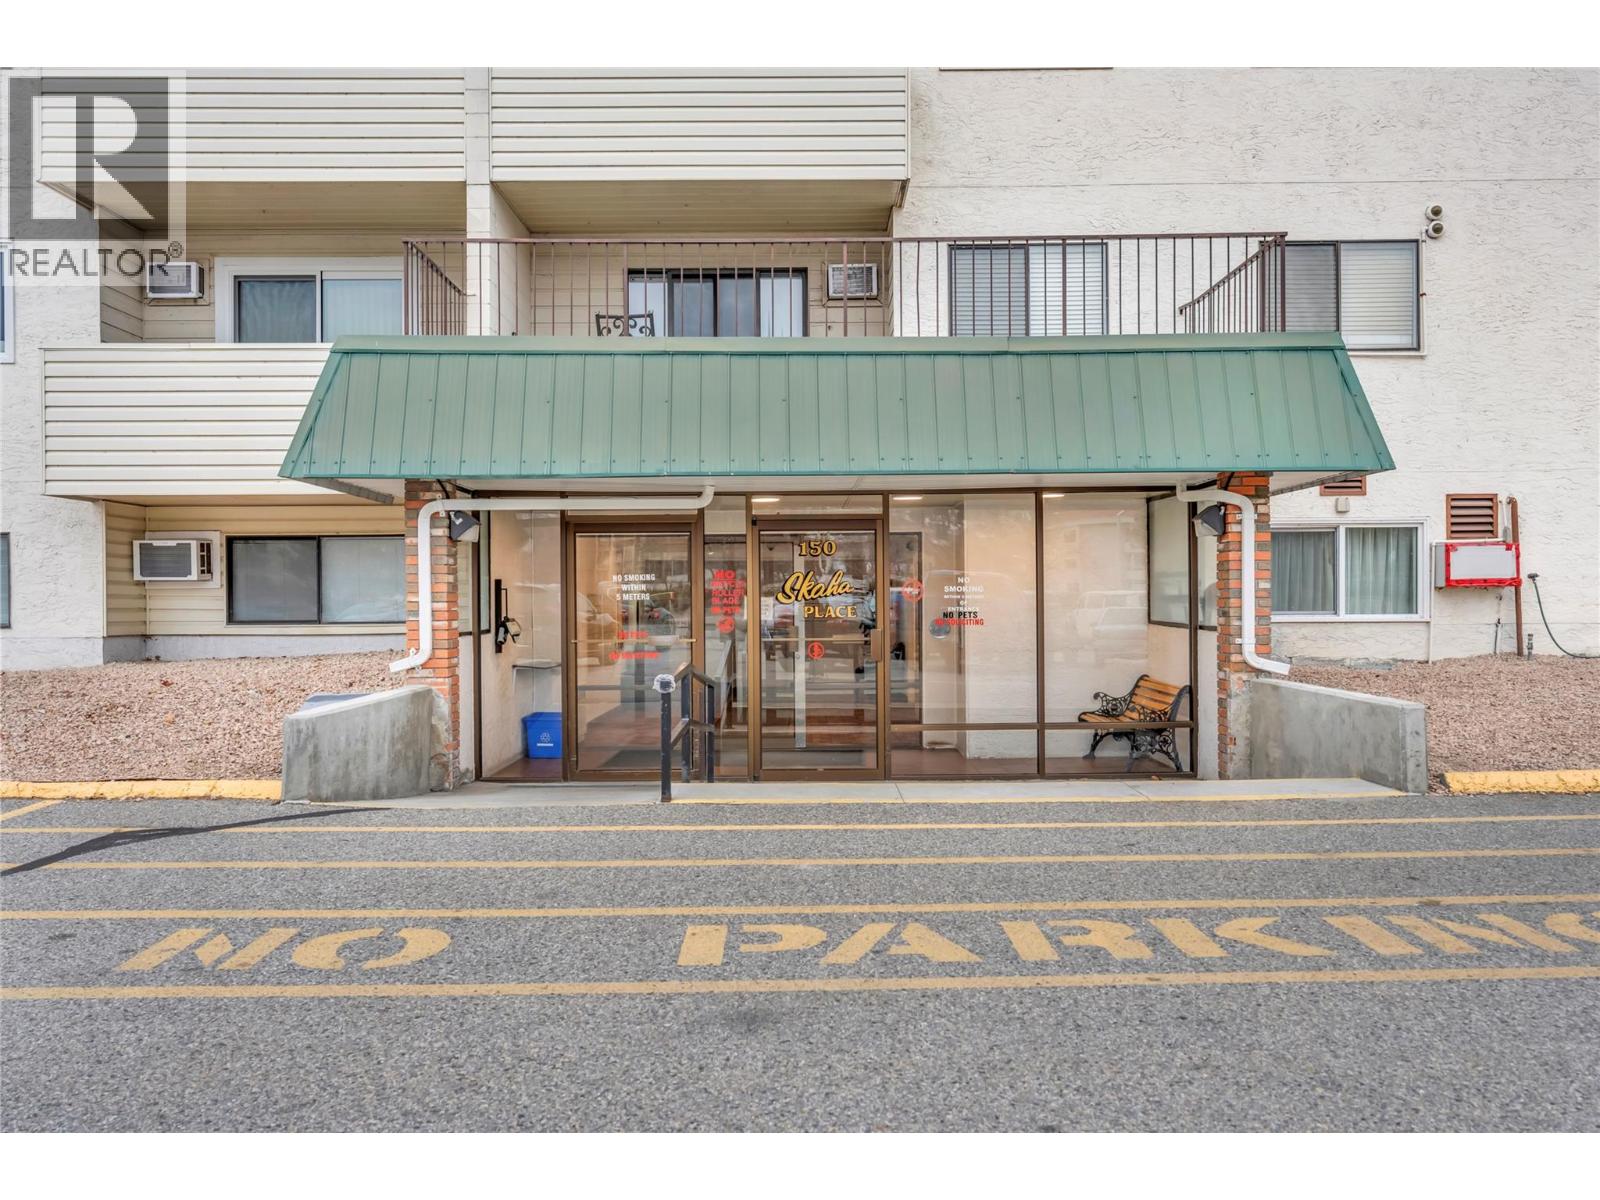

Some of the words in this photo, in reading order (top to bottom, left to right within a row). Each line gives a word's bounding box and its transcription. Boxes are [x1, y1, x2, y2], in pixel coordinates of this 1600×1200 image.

[799, 540, 837, 556] 150
[612, 574, 622, 582] NO
[624, 573, 656, 582] SMOKING
[776, 570, 855, 604] Skaha
[616, 593, 621, 601] 5
[622, 593, 650, 601] METERS
[804, 605, 857, 618] PLACE
[942, 611, 954, 619] NO
[958, 611, 978, 619] PETS
[113, 927, 452, 971] NO
